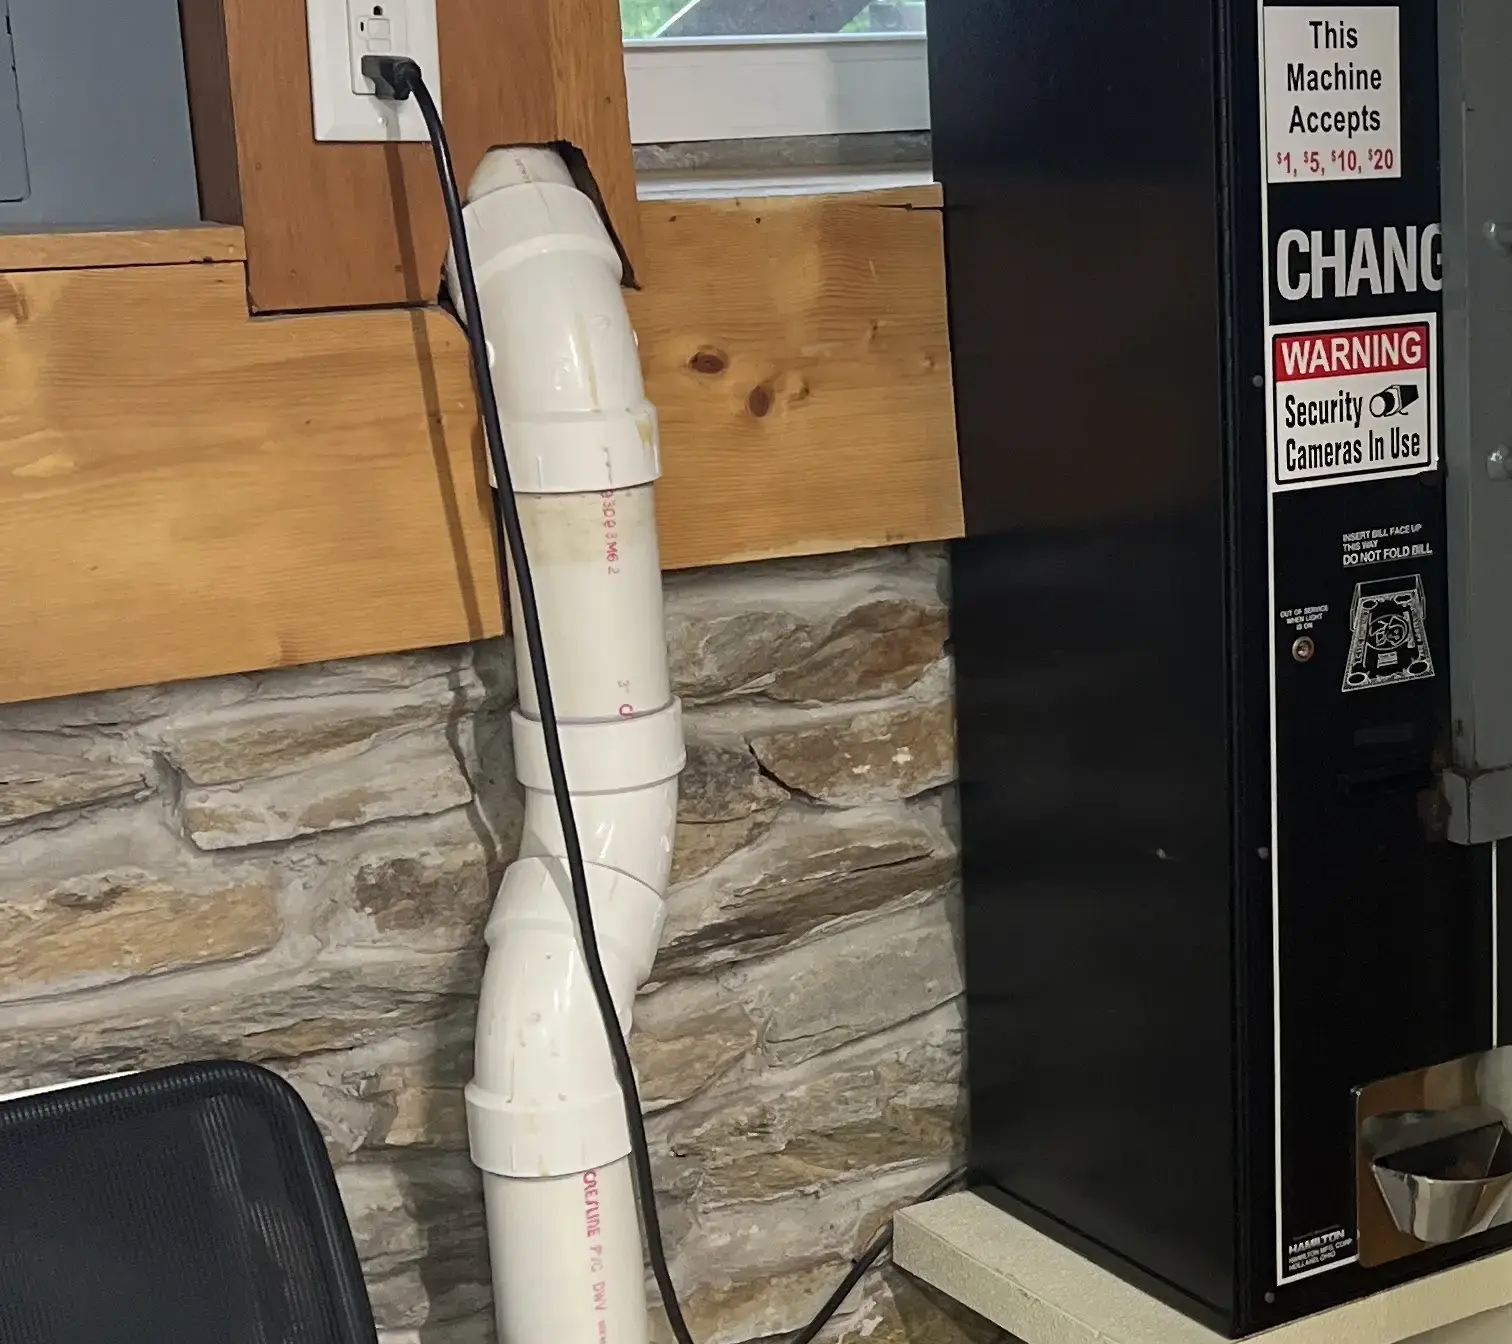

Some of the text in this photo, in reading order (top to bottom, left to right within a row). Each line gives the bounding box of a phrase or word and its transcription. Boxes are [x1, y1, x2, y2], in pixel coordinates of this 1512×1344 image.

[1309, 21, 1358, 49] This
[1287, 62, 1382, 91] Machine
[1289, 105, 1381, 139] Accepts
[1276, 148, 1394, 177] $1, $5, $10, $20
[1281, 331, 1422, 376] WARNING
[1285, 390, 1363, 428] Security
[1286, 427, 1420, 472] Cameras In Use
[1342, 523, 1422, 542] INSERT BILL FACE UP
[1343, 540, 1378, 552] THIS WAY
[1343, 543, 1433, 565] DO NOT FOLD BILL
[1289, 1229, 1345, 1255] HAMILTON
